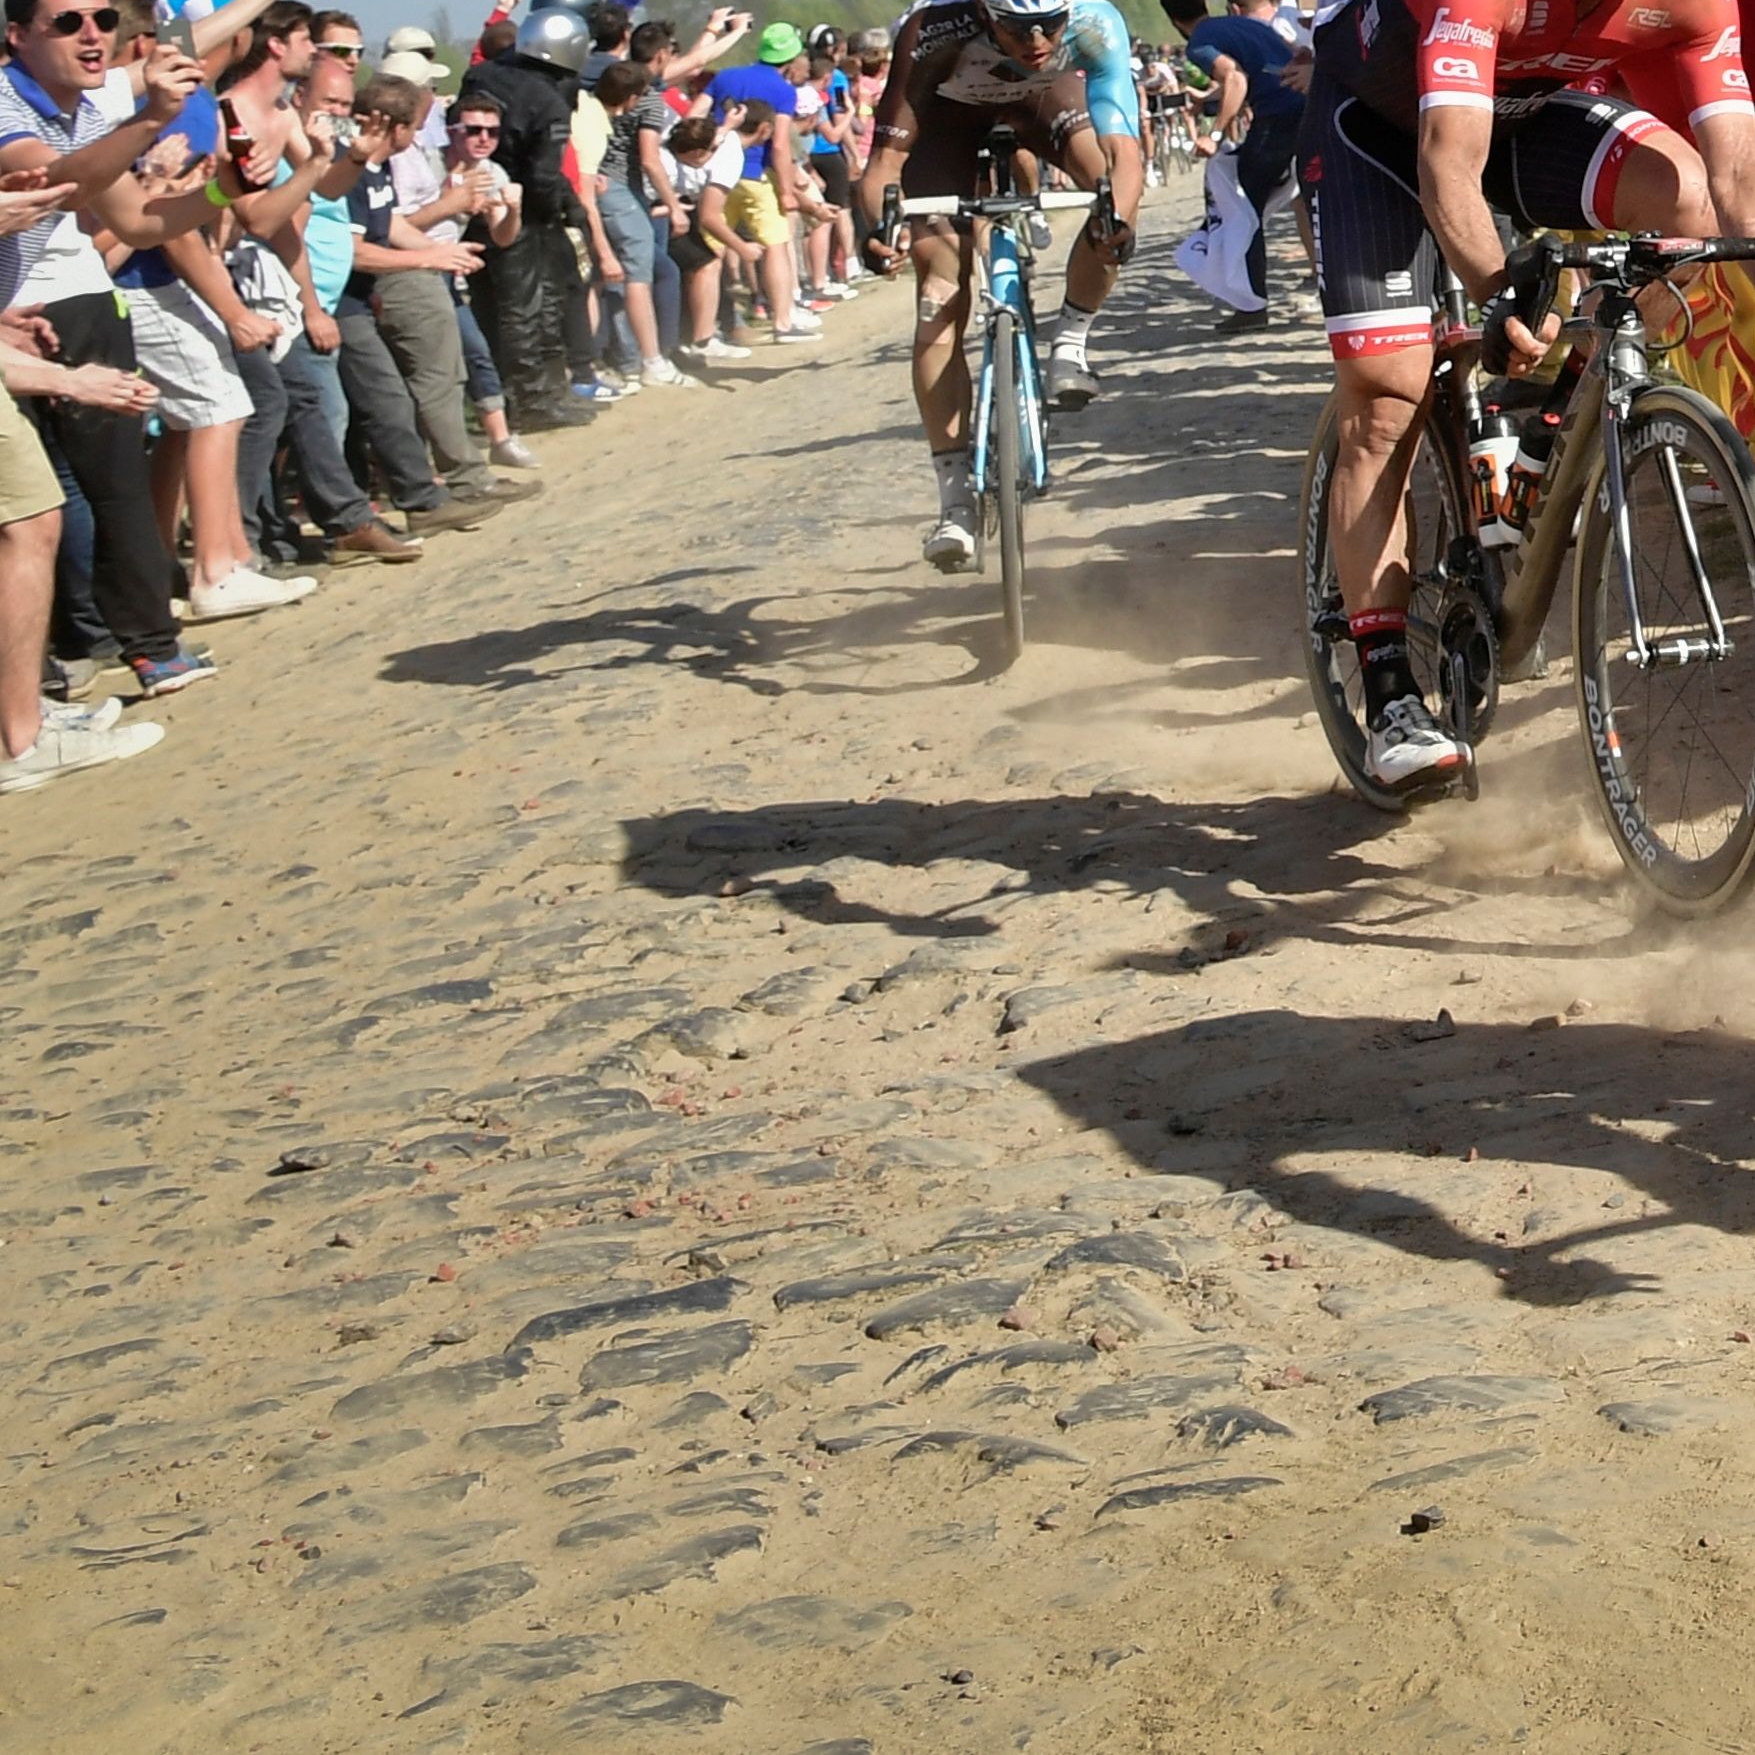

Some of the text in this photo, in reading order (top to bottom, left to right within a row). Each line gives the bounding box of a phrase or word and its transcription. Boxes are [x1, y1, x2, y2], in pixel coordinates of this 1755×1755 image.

[1432, 57, 1479, 80] ca
[1370, 331, 1430, 345] TREK
[1584, 674, 1657, 866] BONTRAGER
